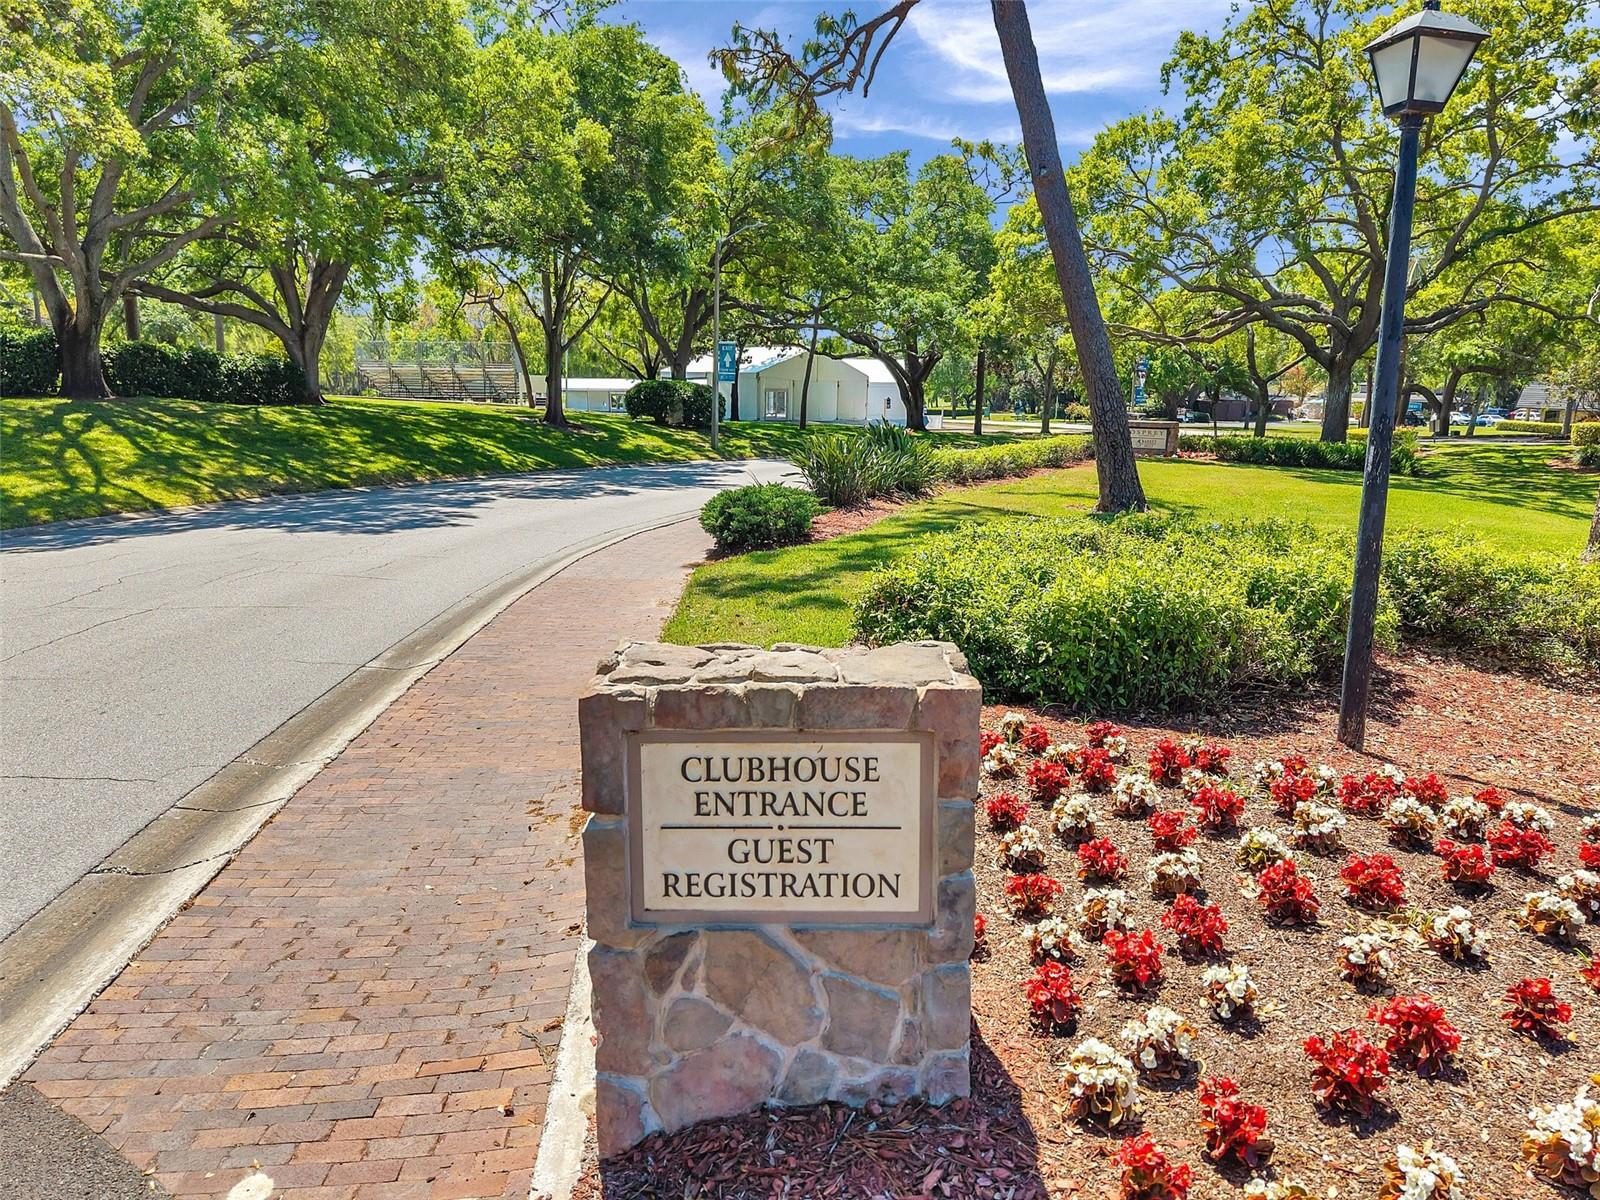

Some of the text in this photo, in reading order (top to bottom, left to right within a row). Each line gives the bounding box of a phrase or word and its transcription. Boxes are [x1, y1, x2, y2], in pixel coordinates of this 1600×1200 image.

[681, 757, 881, 783] CLUBHOUSE
[694, 791, 868, 817] ENTRANCE
[728, 838, 835, 864] GUEST
[662, 872, 901, 899] REGISTRATION
